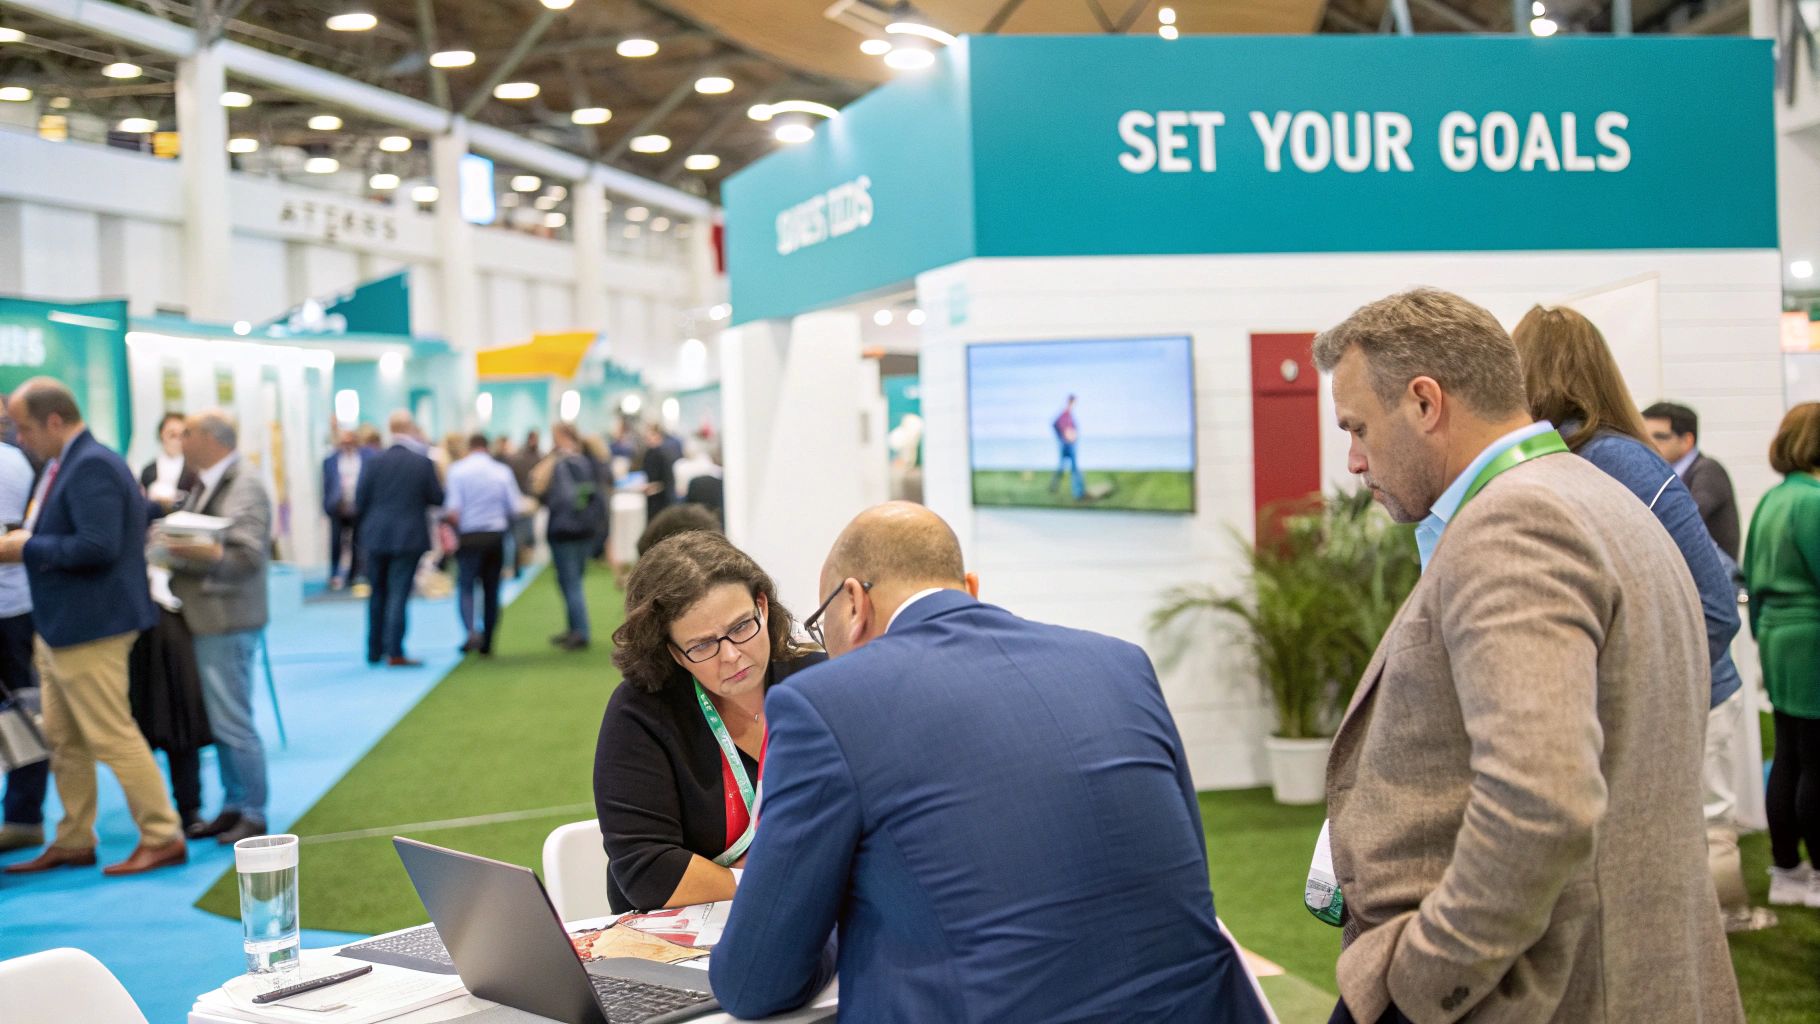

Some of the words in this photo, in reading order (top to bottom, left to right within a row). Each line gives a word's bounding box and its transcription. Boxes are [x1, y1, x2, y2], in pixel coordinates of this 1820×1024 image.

[1118, 110, 1225, 173] SET
[1250, 110, 1413, 172] YOUR
[1438, 110, 1630, 173] GOALS
